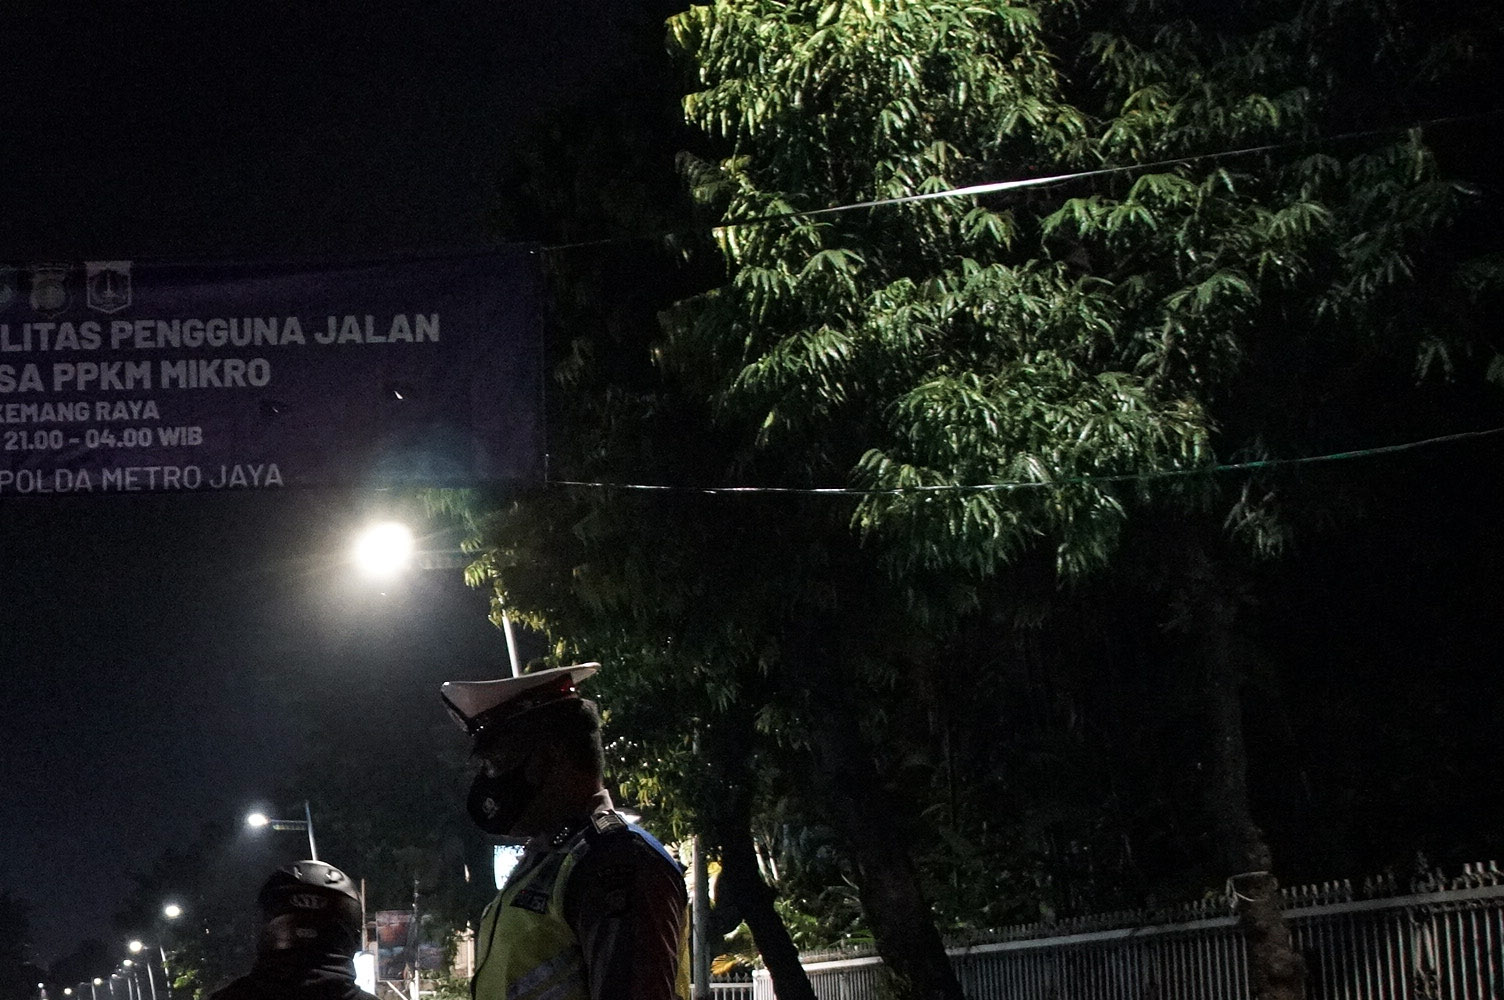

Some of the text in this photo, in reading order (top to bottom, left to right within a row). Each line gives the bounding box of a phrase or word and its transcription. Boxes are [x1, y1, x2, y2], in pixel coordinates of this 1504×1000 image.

[111, 316, 306, 350] PENGGUNA
[314, 313, 440, 345] JALAN
[53, 360, 152, 391] PPKM
[161, 357, 271, 389] MIKRO
[98, 400, 160, 421] RAYA
[5, 429, 64, 451] 21.00
[85, 426, 152, 449] 04.00
[157, 425, 204, 447] WIB
[101, 464, 202, 492] METRO
[209, 463, 284, 488] JAYA
